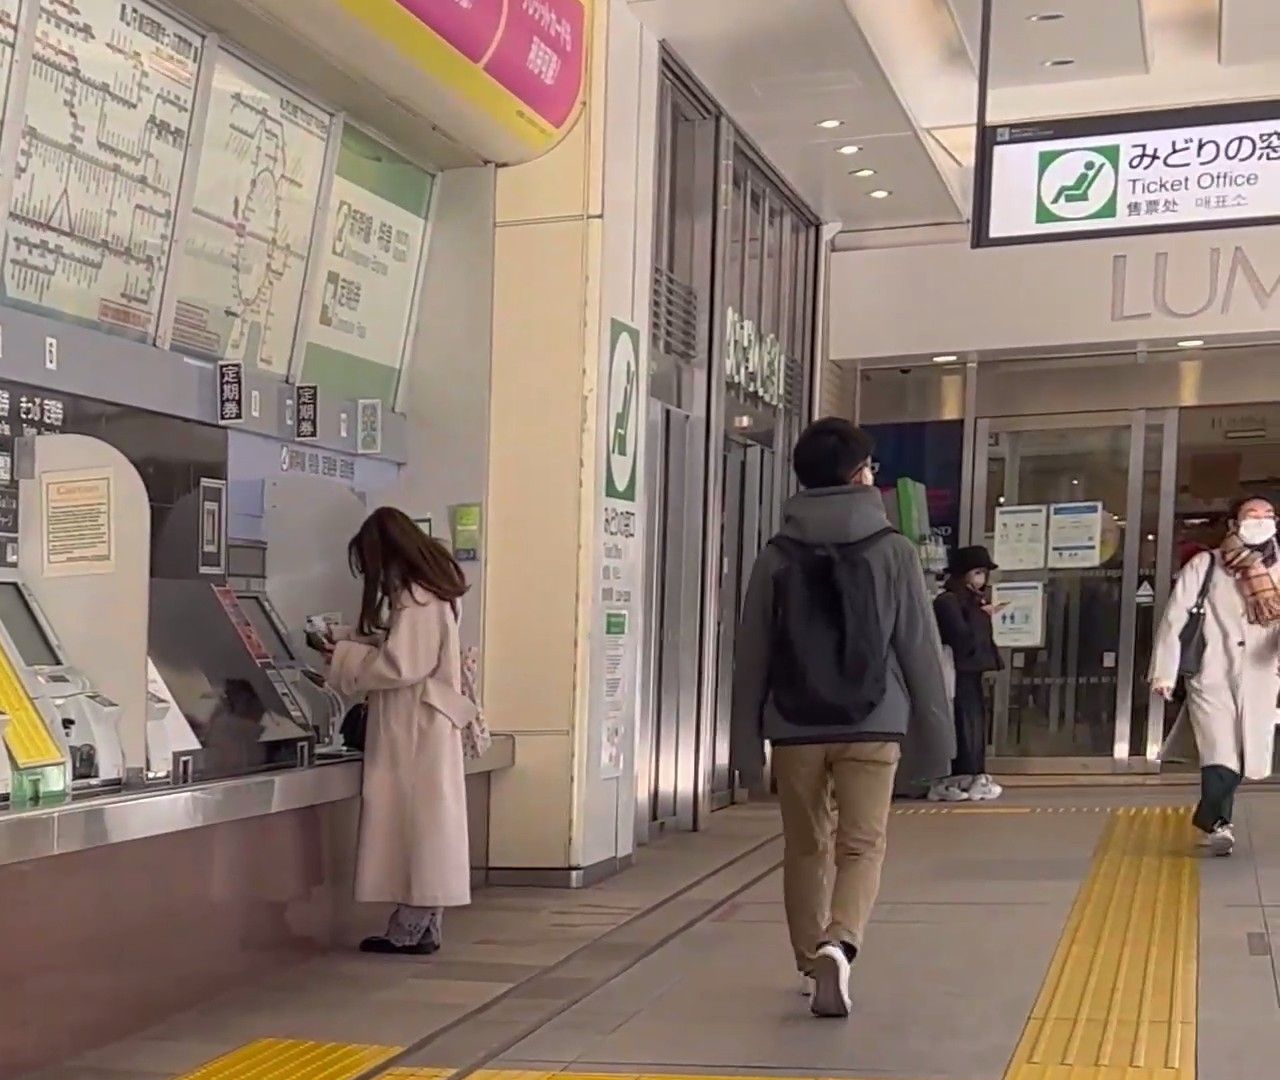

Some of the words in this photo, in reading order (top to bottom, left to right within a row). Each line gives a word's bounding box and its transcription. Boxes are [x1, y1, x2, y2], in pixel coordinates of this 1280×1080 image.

[1128, 175, 1190, 195] Ticket
[1196, 171, 1259, 191] Office
[1127, 198, 1179, 217] 售票处
[1195, 193, 1249, 210] 매표소
[222, 365, 240, 419] 定期券
[298, 387, 315, 437] 定期券
